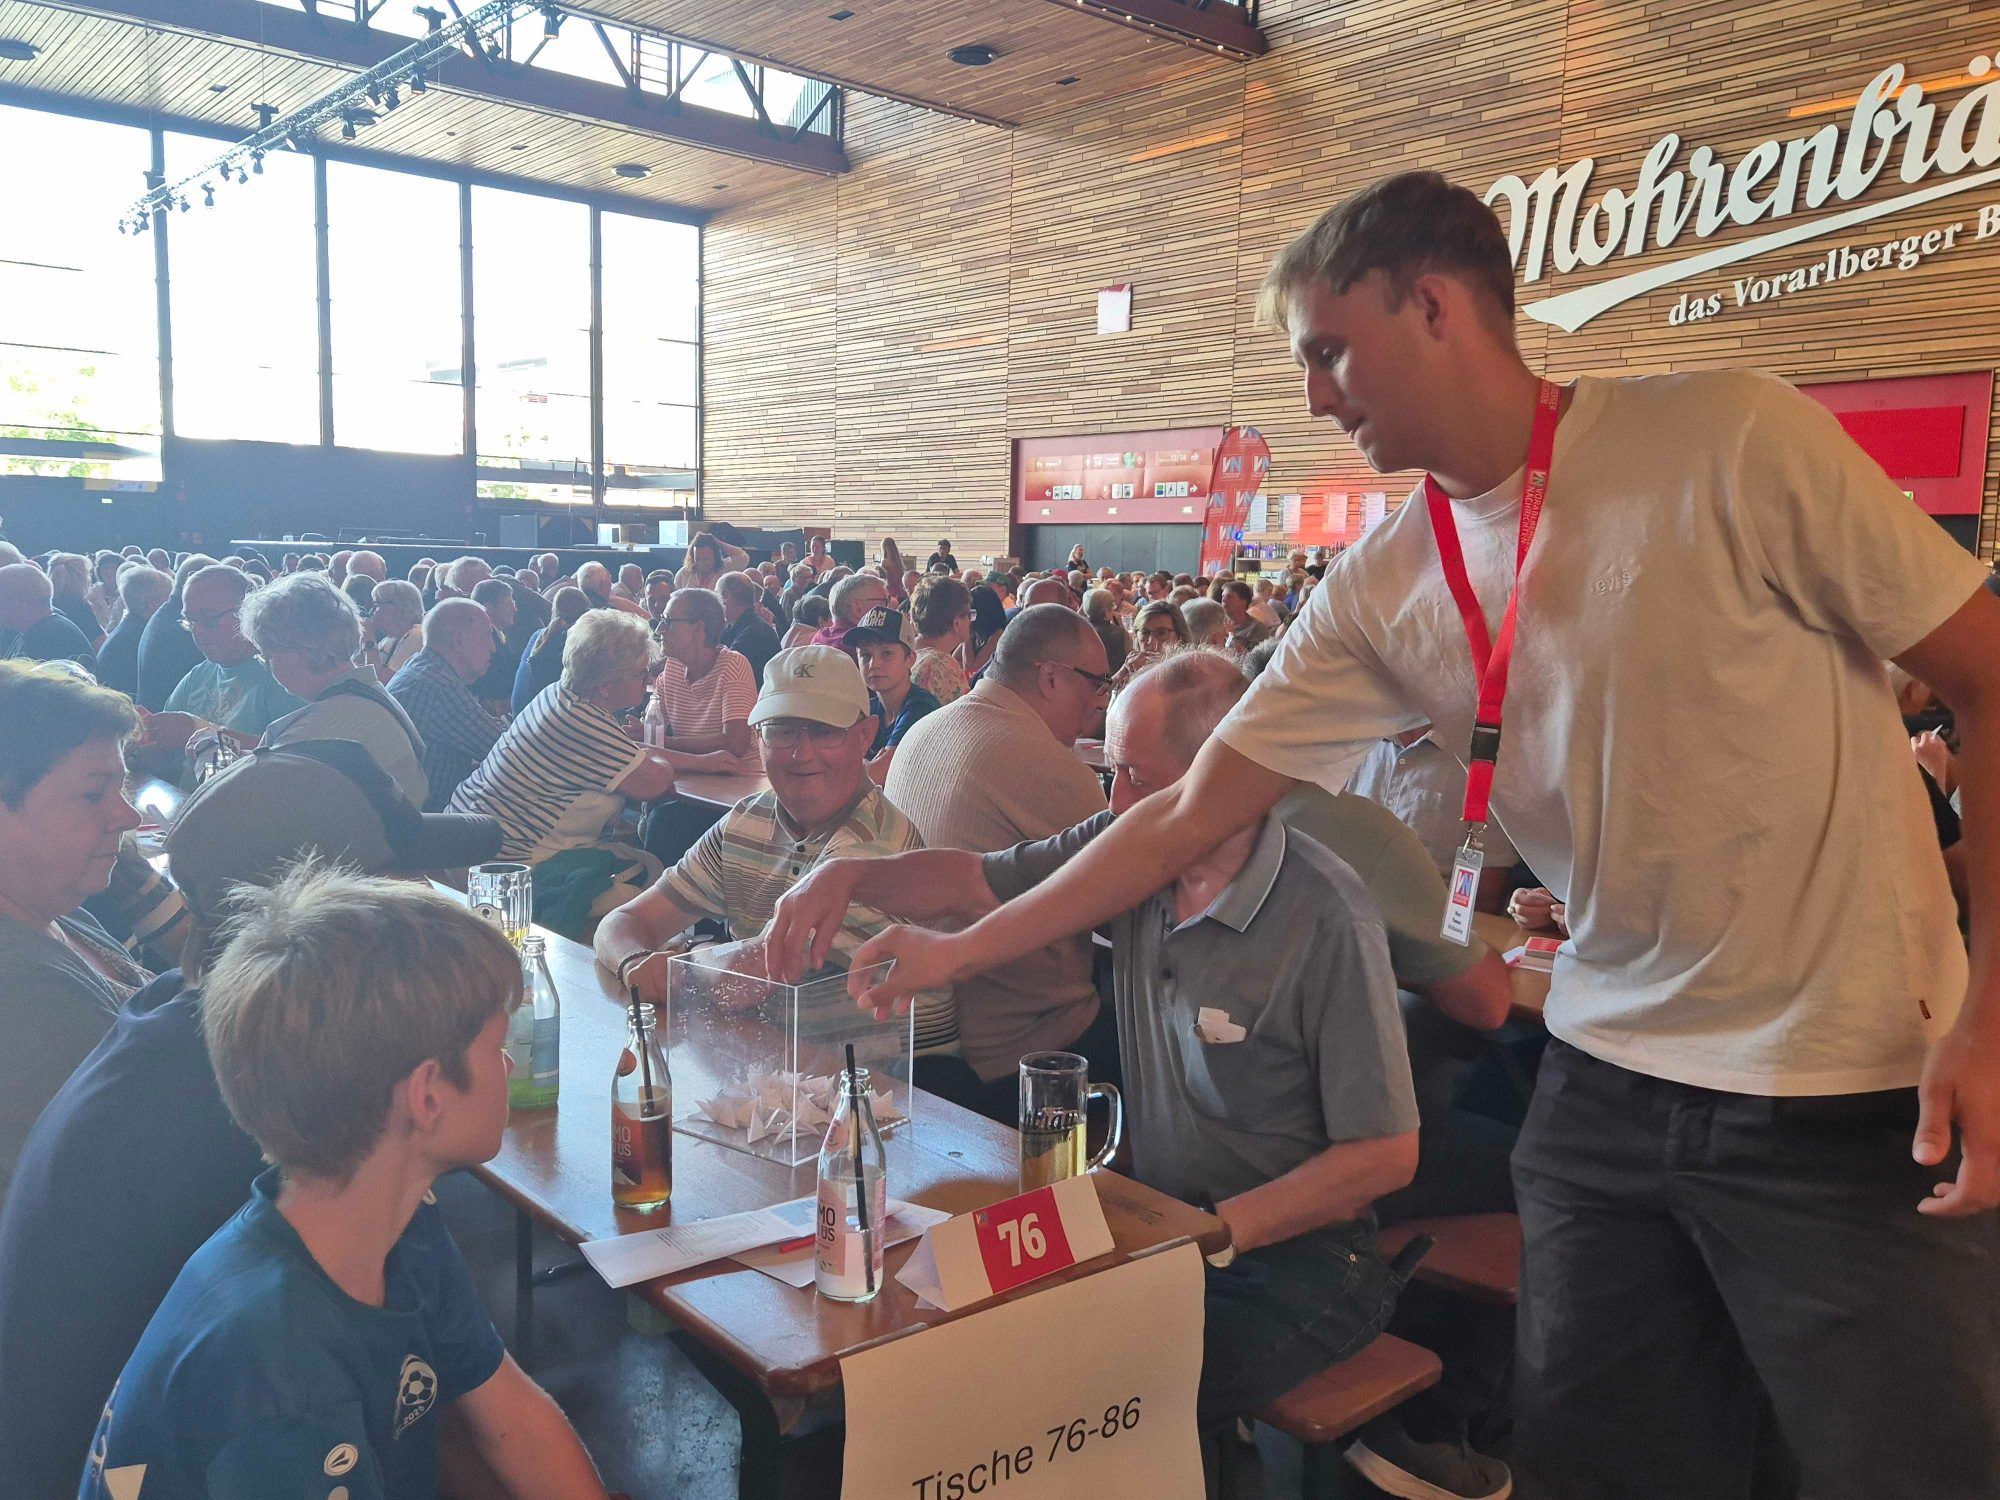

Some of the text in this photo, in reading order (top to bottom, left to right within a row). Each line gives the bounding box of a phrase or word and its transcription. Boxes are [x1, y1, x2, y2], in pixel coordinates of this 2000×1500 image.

[1668, 291, 1721, 326] das
[1732, 222, 1963, 307] Vorarlberger
[996, 1212, 1047, 1268] 76
[911, 1396, 1142, 1500] Tische 76-86
